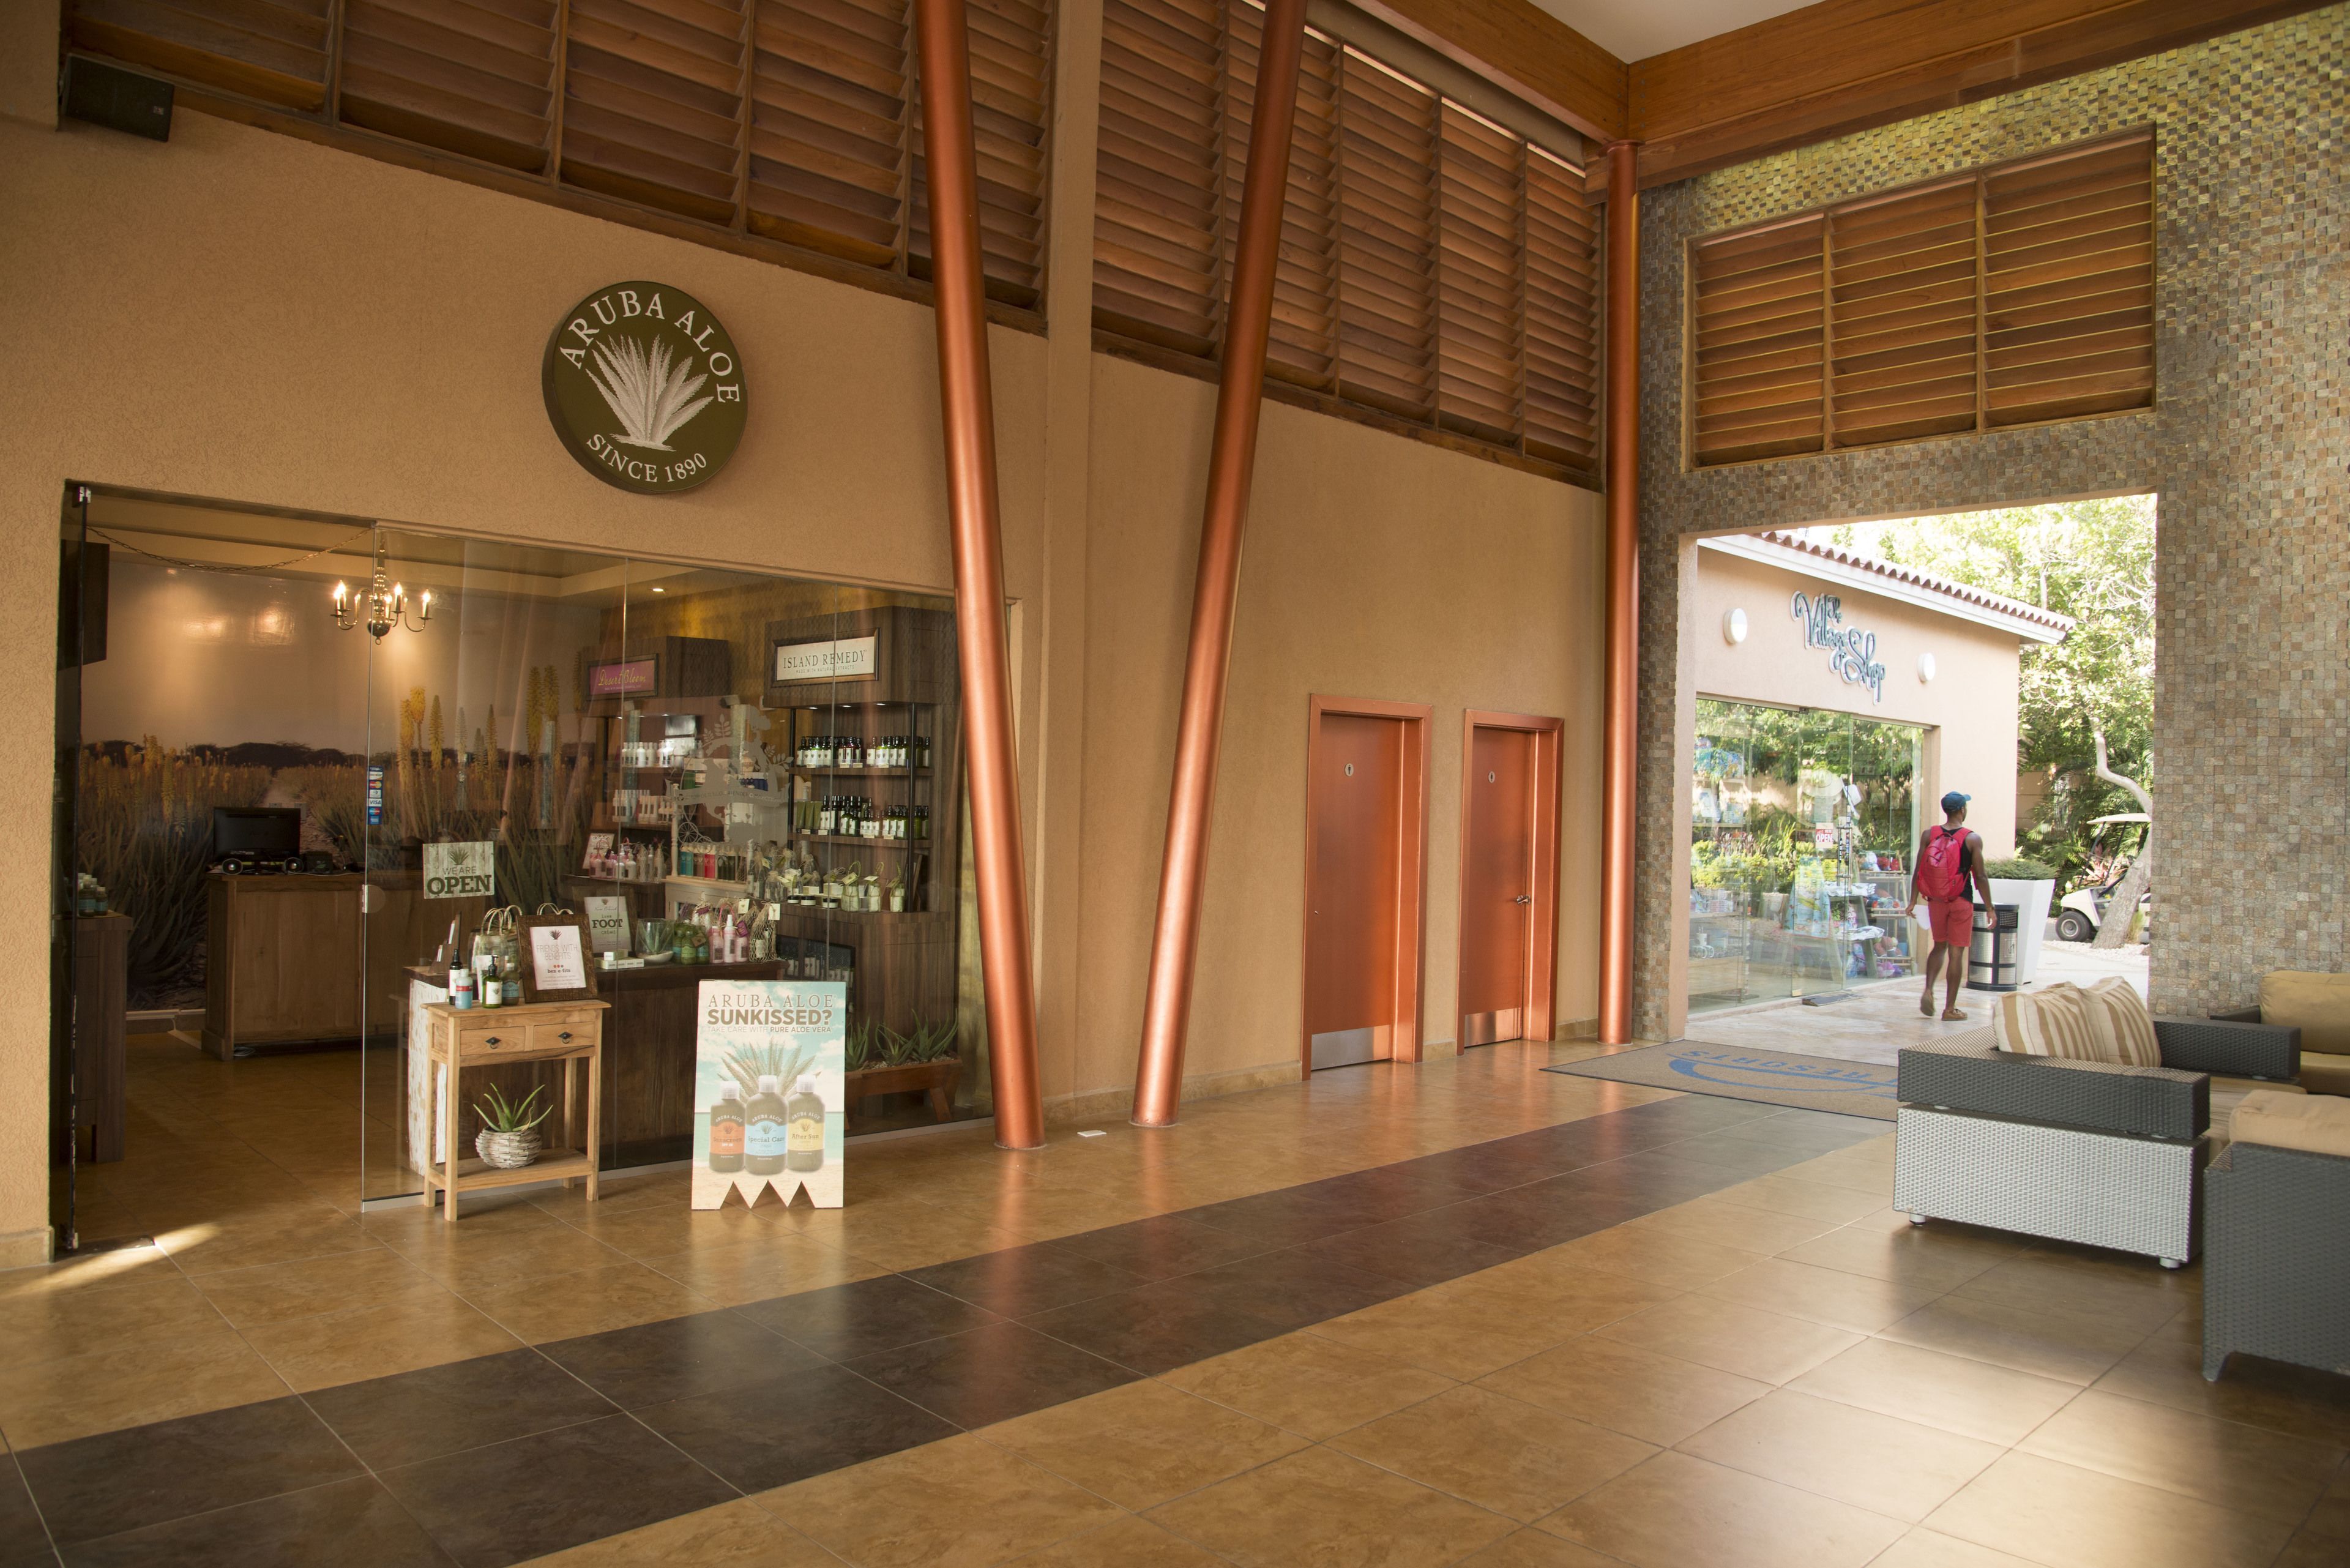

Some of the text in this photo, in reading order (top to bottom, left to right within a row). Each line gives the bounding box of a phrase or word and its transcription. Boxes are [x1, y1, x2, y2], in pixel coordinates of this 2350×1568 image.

[559, 290, 740, 403] ARUBA ALOE
[586, 433, 706, 482] SINCE 1890
[1791, 591, 1847, 673] Village
[783, 650, 865, 668] ISLAND REMEDY
[1841, 625, 1886, 704] Shop
[624, 668, 646, 684] Bloom
[1816, 834, 1833, 842] OPEN
[427, 875, 491, 894] OPEN
[592, 919, 623, 928] FOOT
[708, 995, 833, 1007] ARUBA ALOE
[707, 1009, 832, 1025] SUNKISSED?
[1681, 1050, 1873, 1078] RESORTS
[752, 1114, 767, 1122] ARUBA
